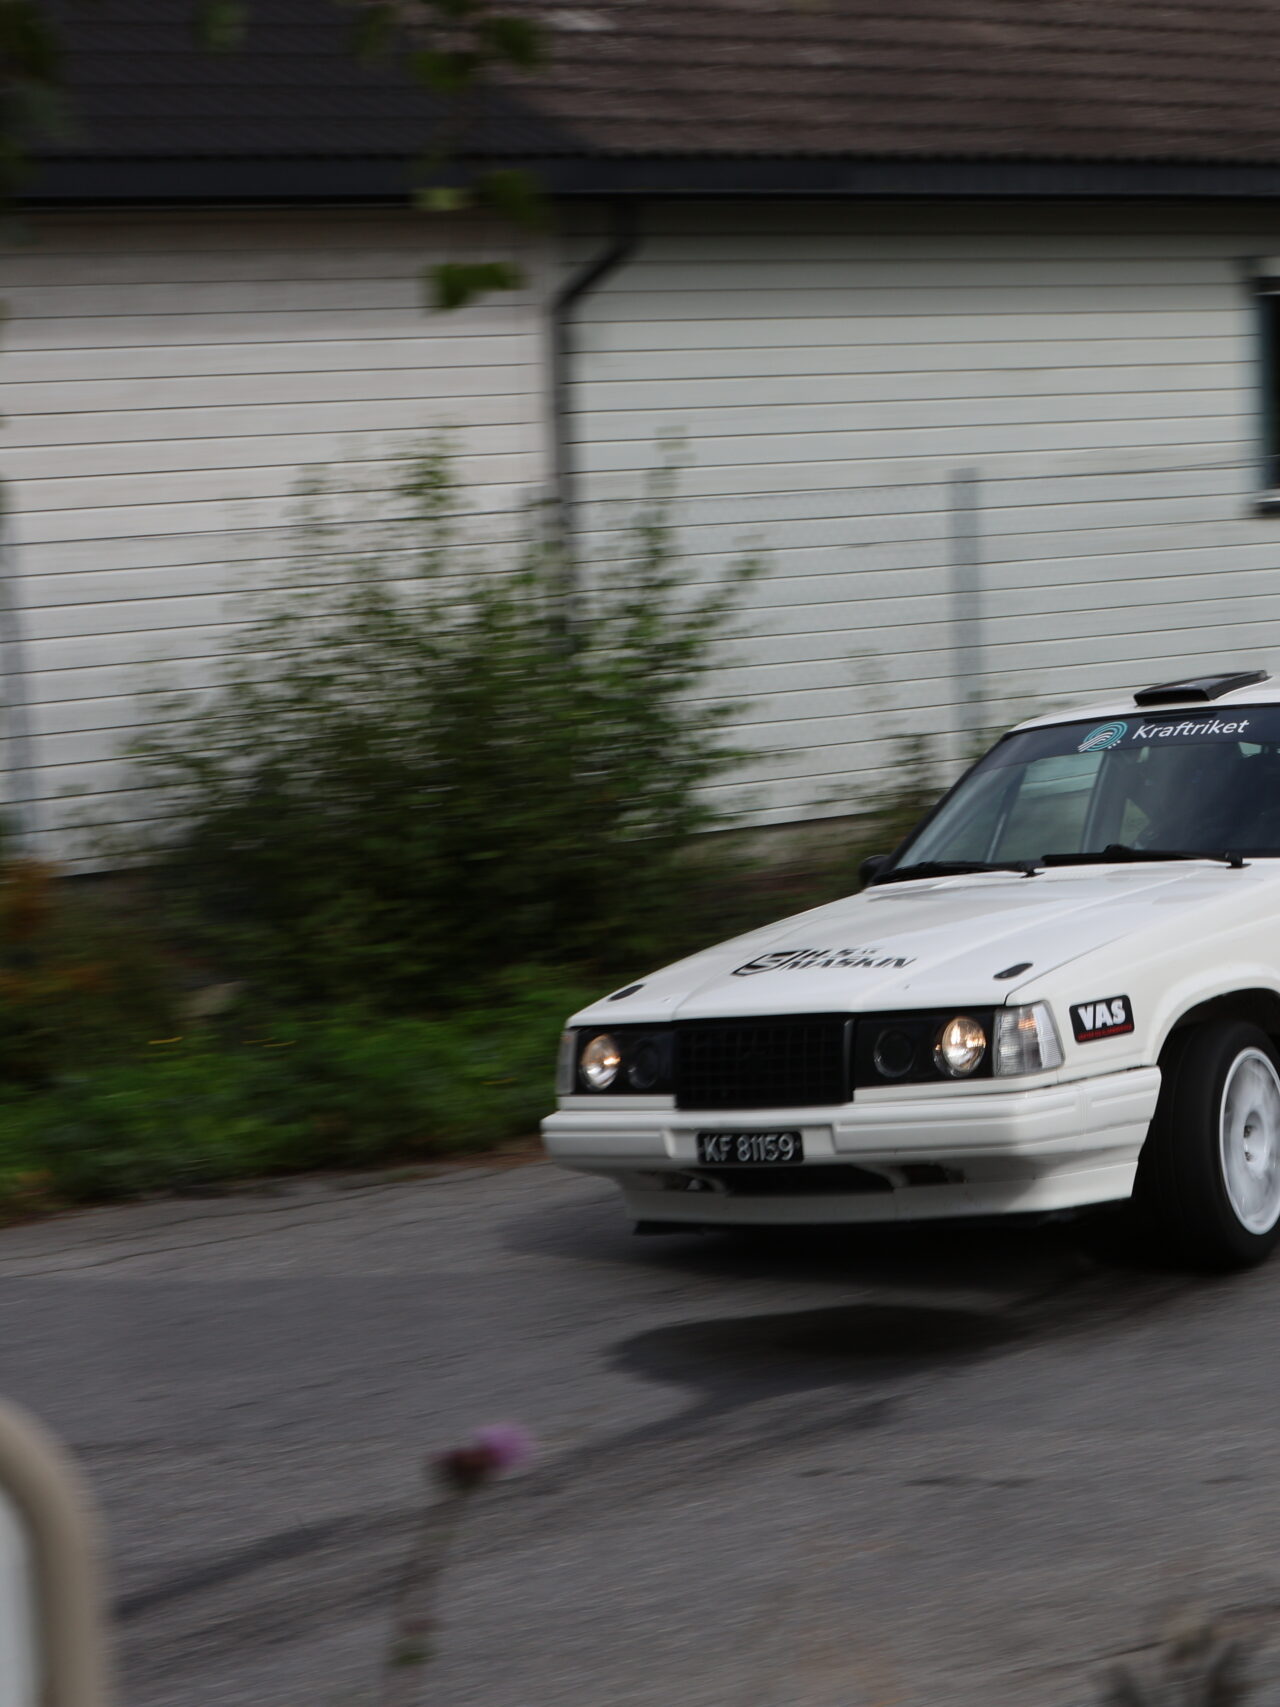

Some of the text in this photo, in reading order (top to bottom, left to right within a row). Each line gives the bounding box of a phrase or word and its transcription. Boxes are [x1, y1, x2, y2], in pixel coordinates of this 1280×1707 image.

[1132, 719, 1250, 740] Kraftriket
[1077, 998, 1126, 1031] VAS
[703, 1133, 795, 1162] KF 81159
